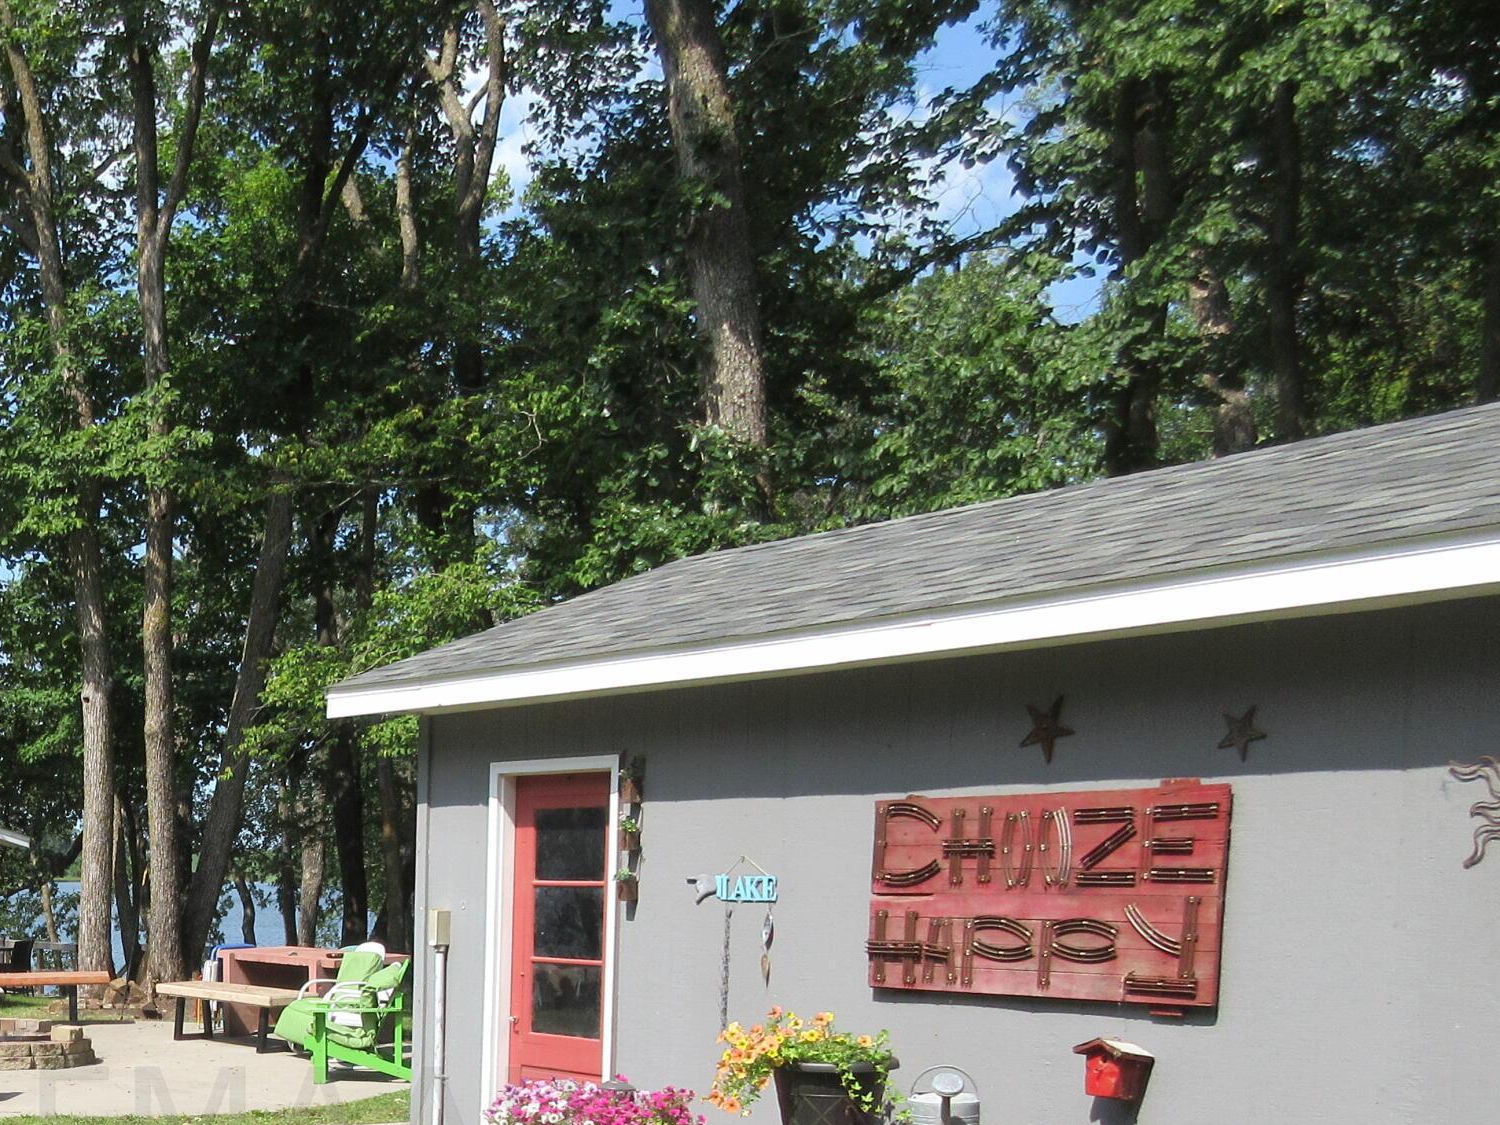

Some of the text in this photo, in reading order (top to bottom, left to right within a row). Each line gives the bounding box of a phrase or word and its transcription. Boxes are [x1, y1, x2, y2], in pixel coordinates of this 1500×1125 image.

[714, 874, 778, 903] LAKE
[874, 802, 1219, 890] CHOOZE
[865, 896, 1201, 999] HAPPY
